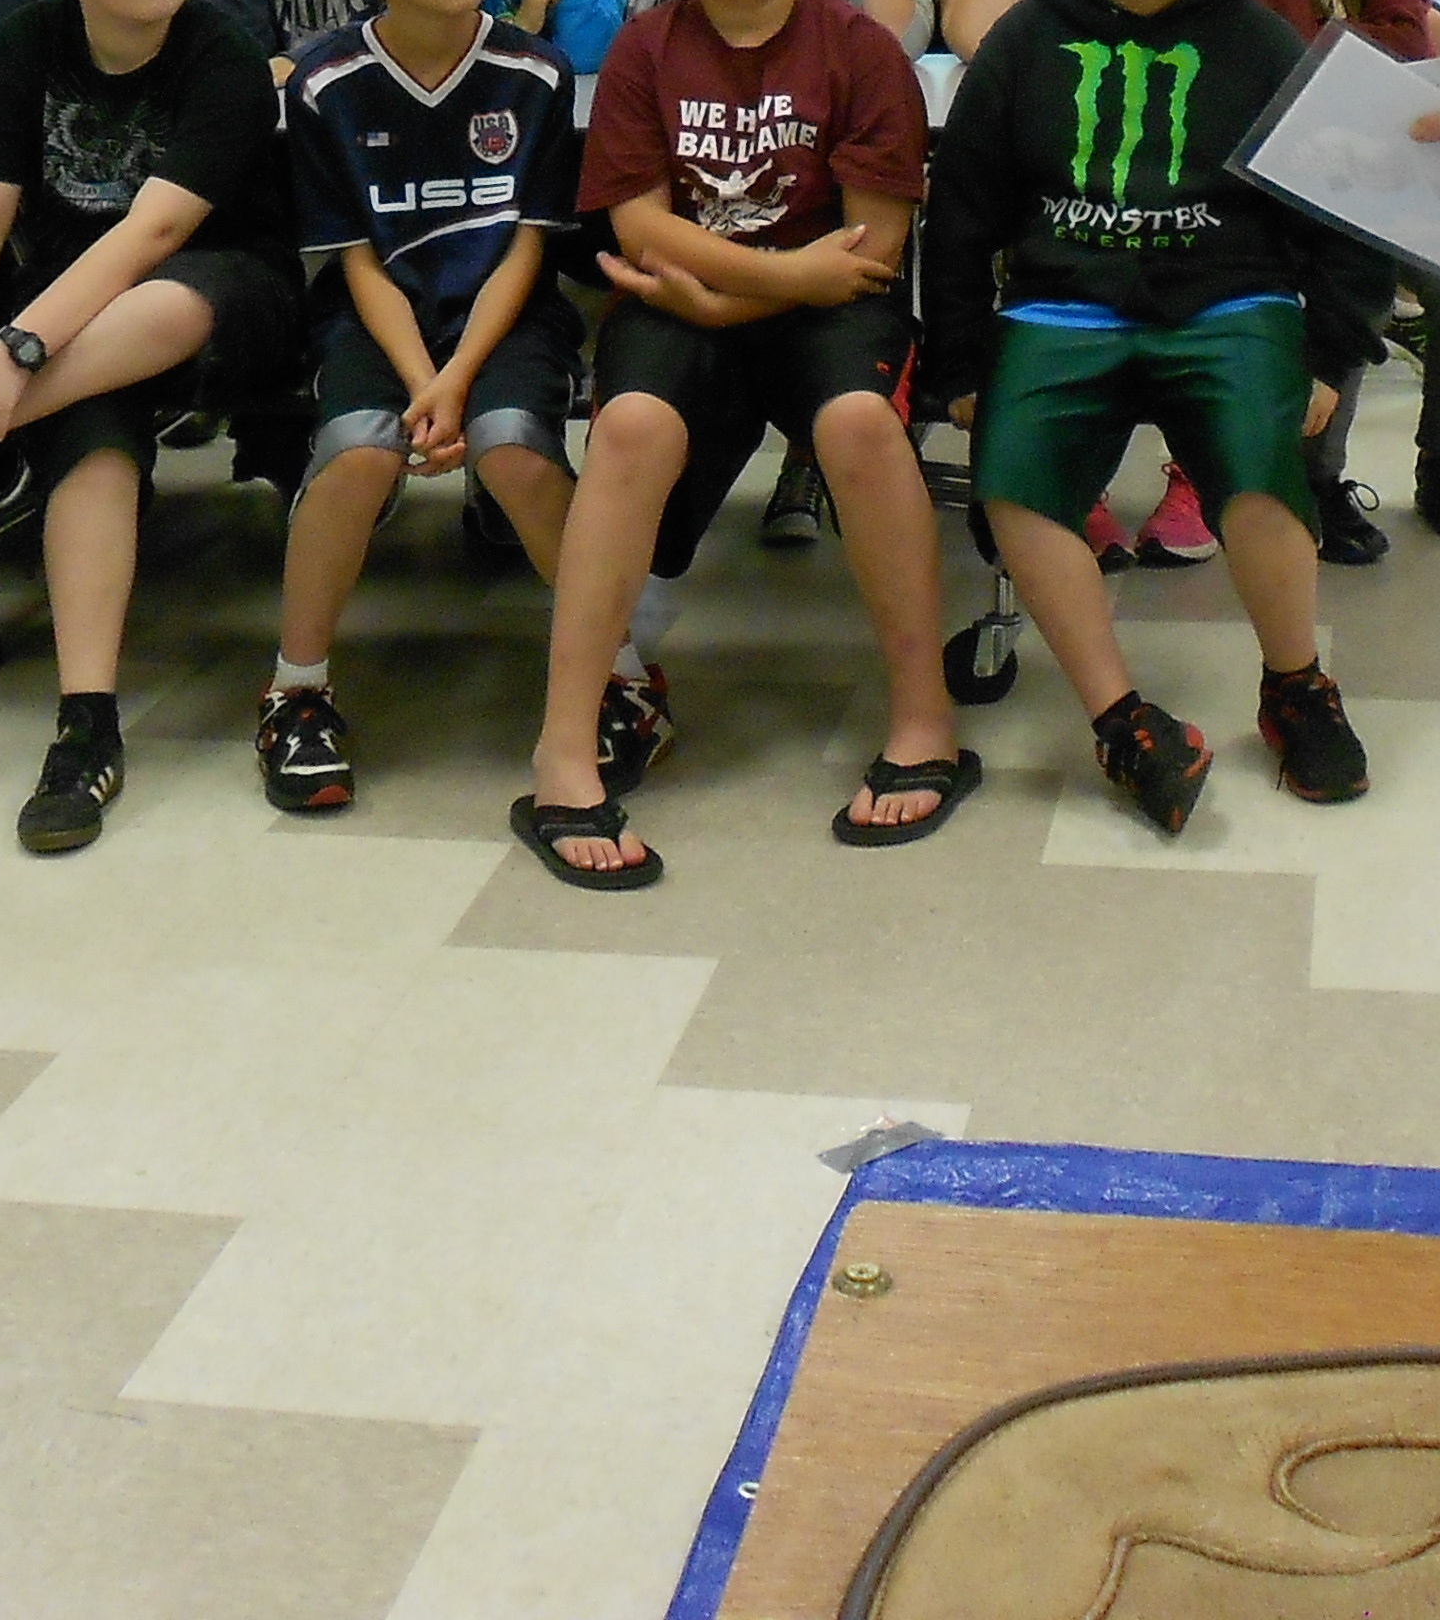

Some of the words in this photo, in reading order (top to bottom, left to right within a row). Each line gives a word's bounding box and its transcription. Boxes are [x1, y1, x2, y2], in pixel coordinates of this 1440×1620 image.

[679, 99, 726, 129] WE
[735, 94, 793, 133] HVE
[676, 120, 818, 164] BALLAME
[1054, 225, 1196, 249] ENERGY
